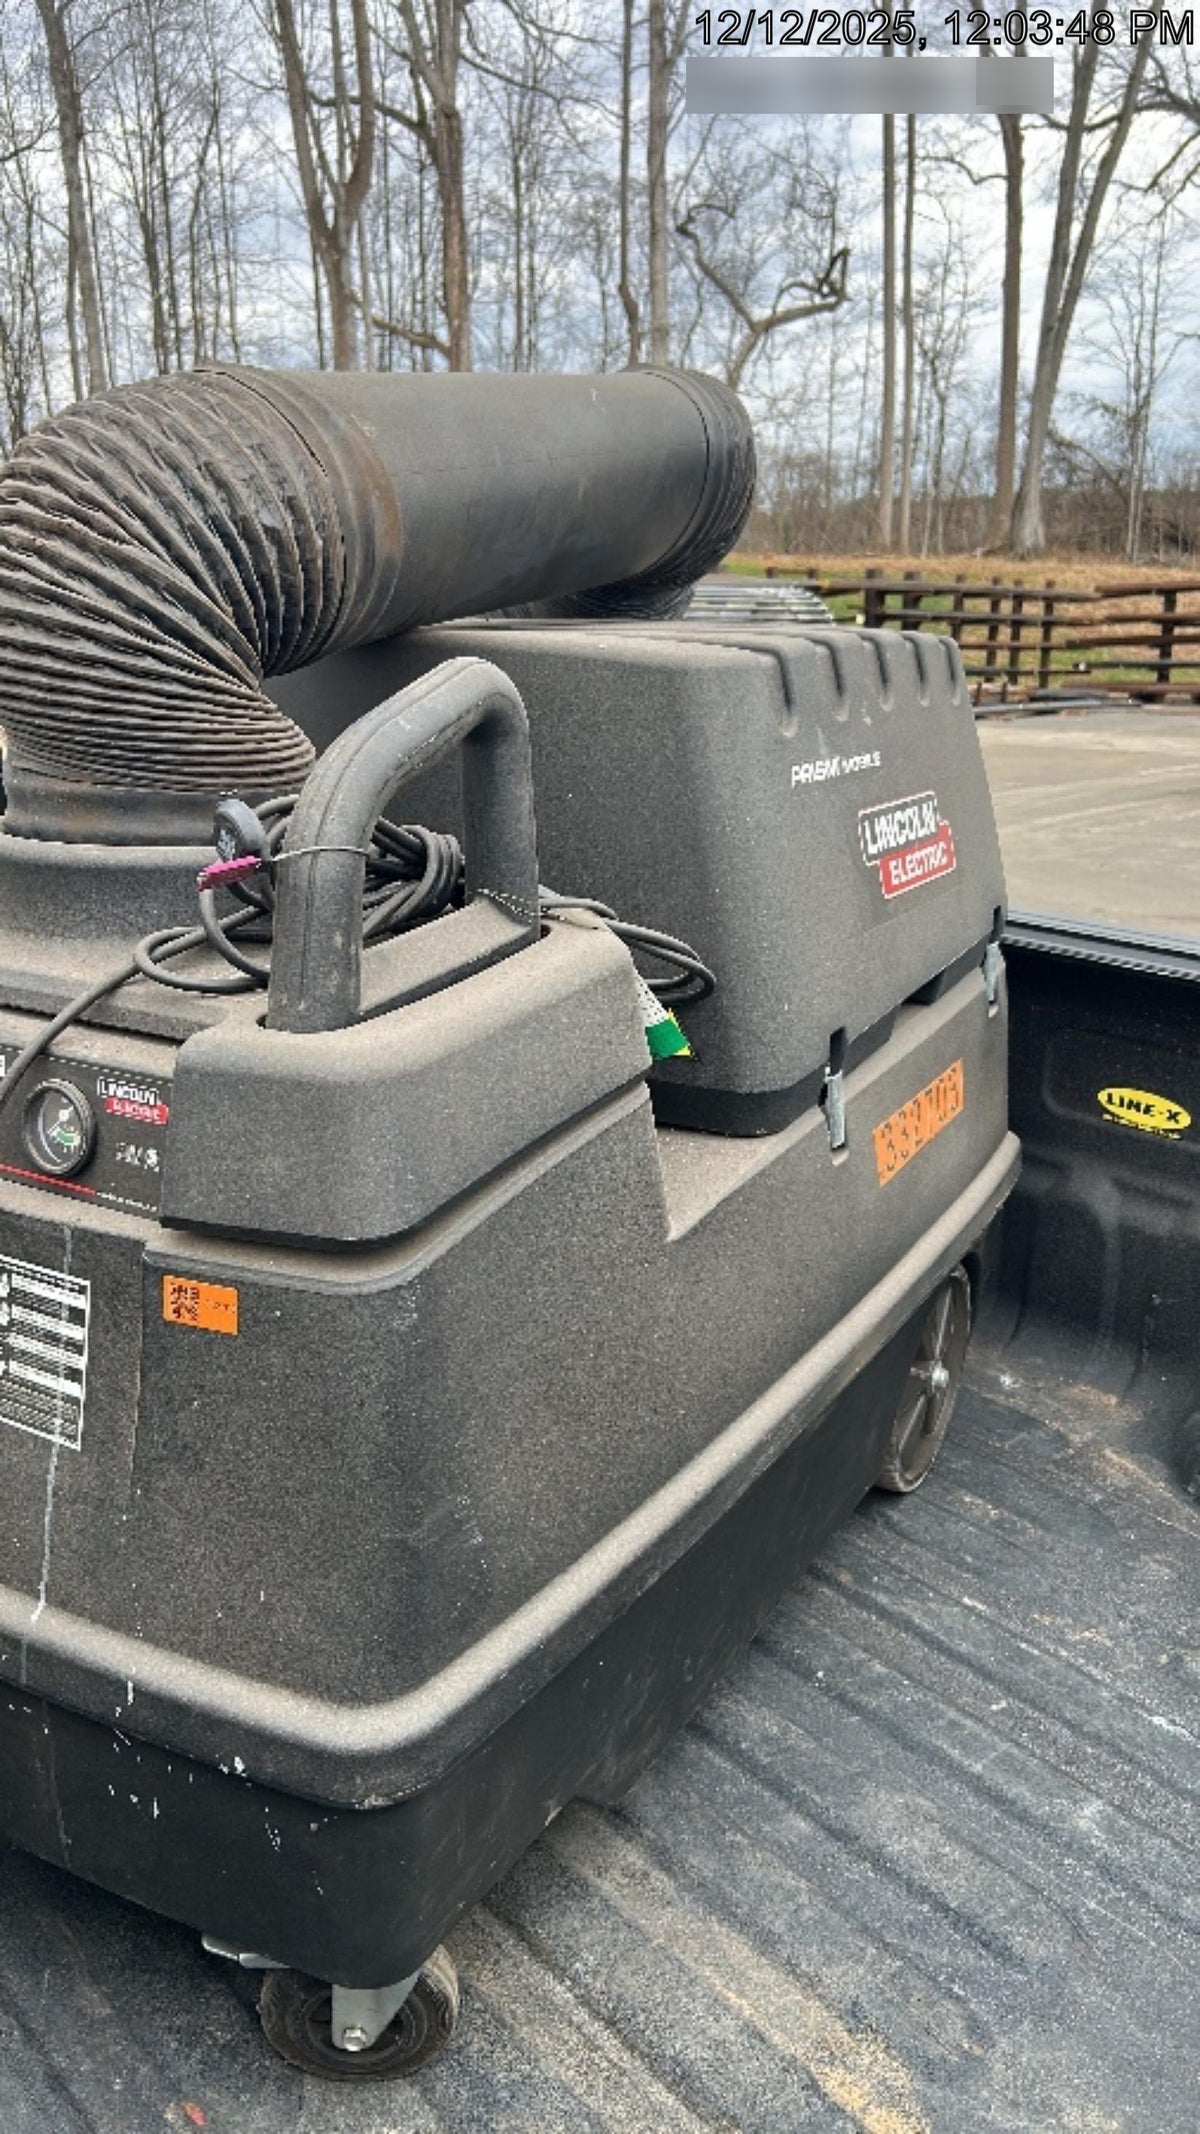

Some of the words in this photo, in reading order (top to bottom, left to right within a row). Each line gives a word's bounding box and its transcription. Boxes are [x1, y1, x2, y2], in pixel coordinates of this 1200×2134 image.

[791, 756, 841, 788] PRISM
[864, 801, 937, 854] LINCOLN
[889, 841, 948, 886] ELECTRIC
[101, 1081, 157, 1106] LINCOLN
[1106, 1092, 1181, 1125] LINE-X
